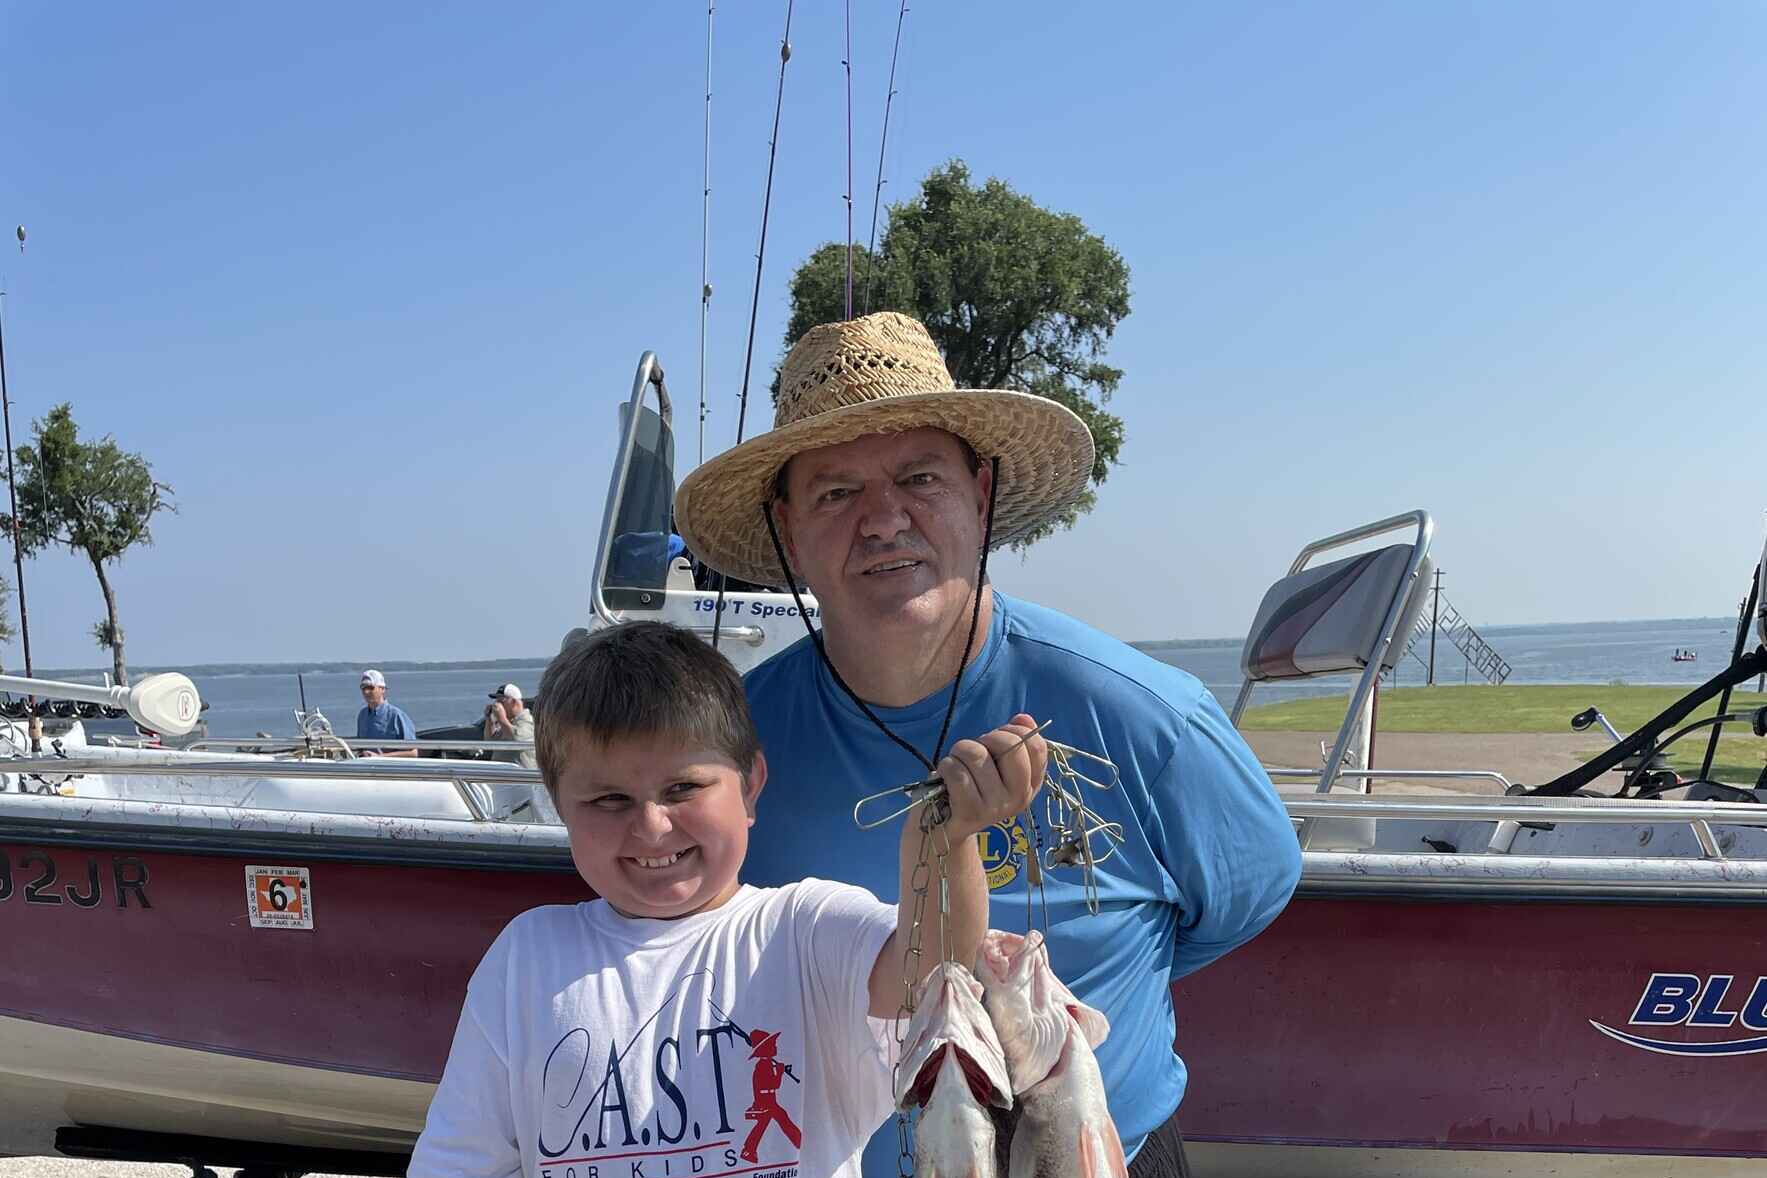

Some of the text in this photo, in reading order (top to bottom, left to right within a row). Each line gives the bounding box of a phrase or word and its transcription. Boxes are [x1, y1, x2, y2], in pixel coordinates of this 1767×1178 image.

[750, 601, 820, 618] Specal
[0, 850, 153, 910] 2JR
[269, 878, 288, 911] 6
